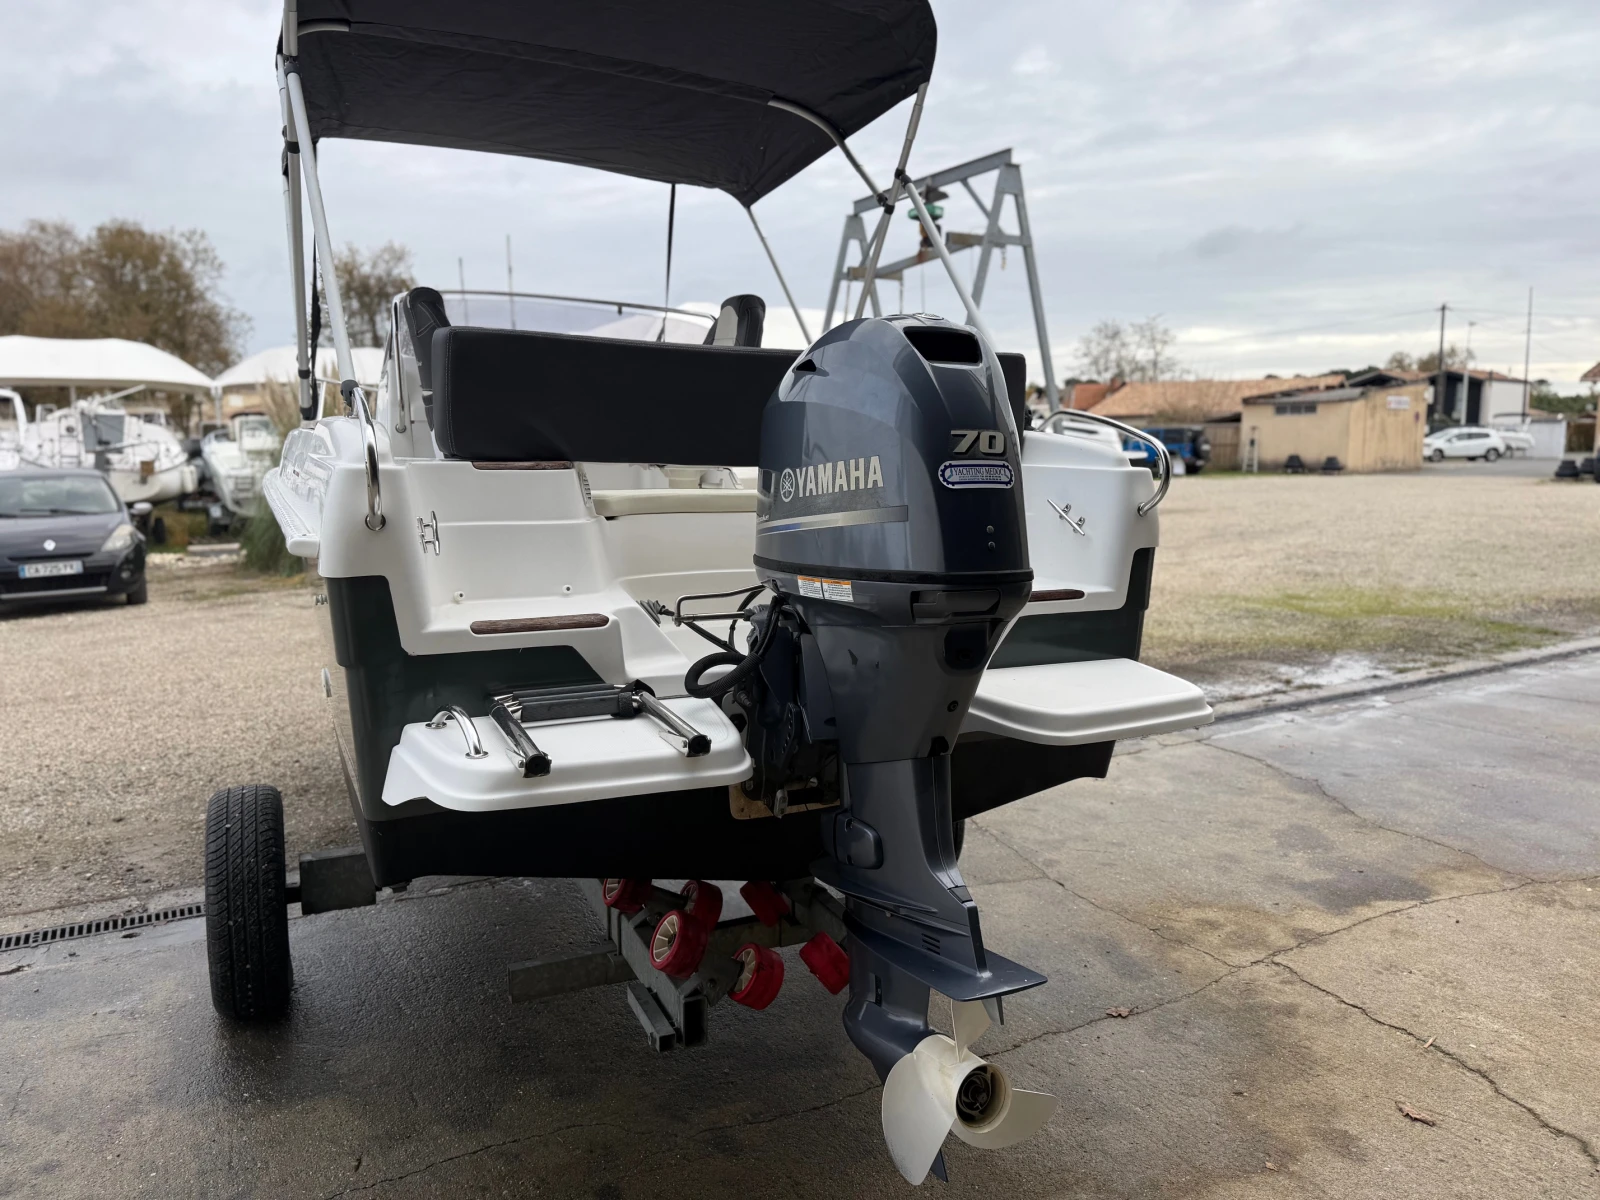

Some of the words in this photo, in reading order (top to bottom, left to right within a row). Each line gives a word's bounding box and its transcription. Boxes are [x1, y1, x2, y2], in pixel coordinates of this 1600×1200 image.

[951, 430, 1004, 453] 70
[796, 456, 883, 497] YAMAHA
[954, 467, 984, 475] YACHTING
